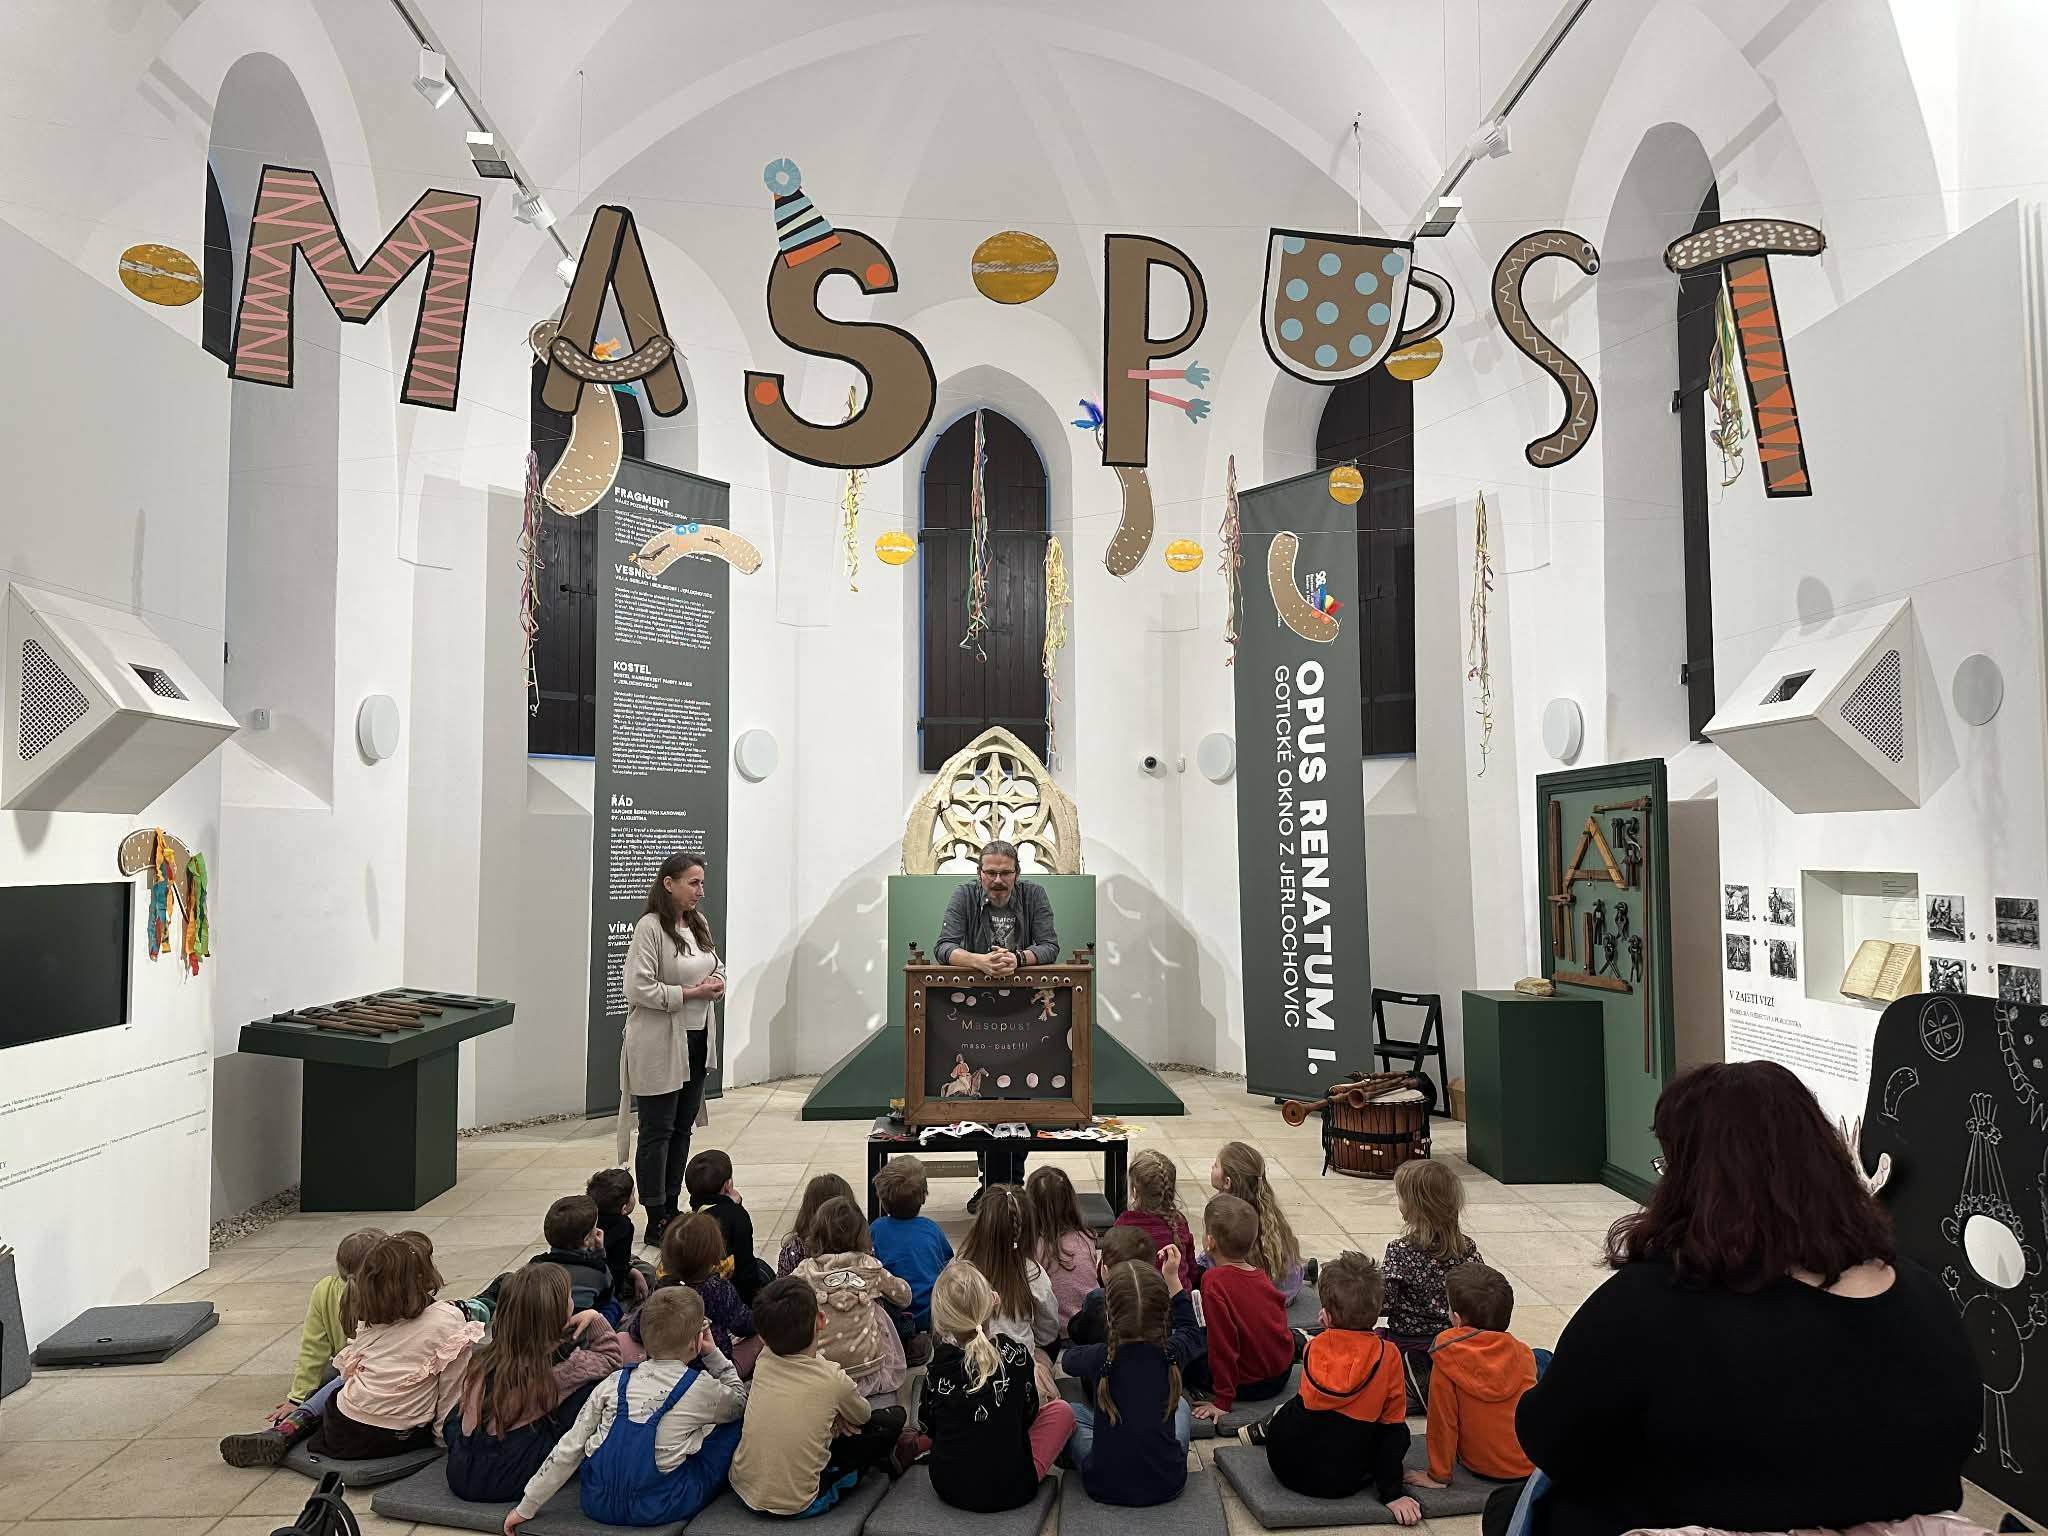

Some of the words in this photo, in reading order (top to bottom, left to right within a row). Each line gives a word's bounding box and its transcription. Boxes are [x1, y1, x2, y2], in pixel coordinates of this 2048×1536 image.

[613, 486, 670, 509] FRAGMENT
[613, 660, 652, 675] KOSTEL
[1274, 665, 1296, 763] GOTICKÉ
[1295, 660, 1327, 784] OPUS
[610, 793, 634, 807] ŘÁD
[1277, 768, 1294, 836] OKNO
[1279, 842, 1295, 856] Z
[608, 920, 634, 933] VÍRA
[1299, 799, 1335, 1031] RENATUM
[1279, 862, 1300, 1028] JERLOCHOVIC
[1729, 989, 1735, 999] V
